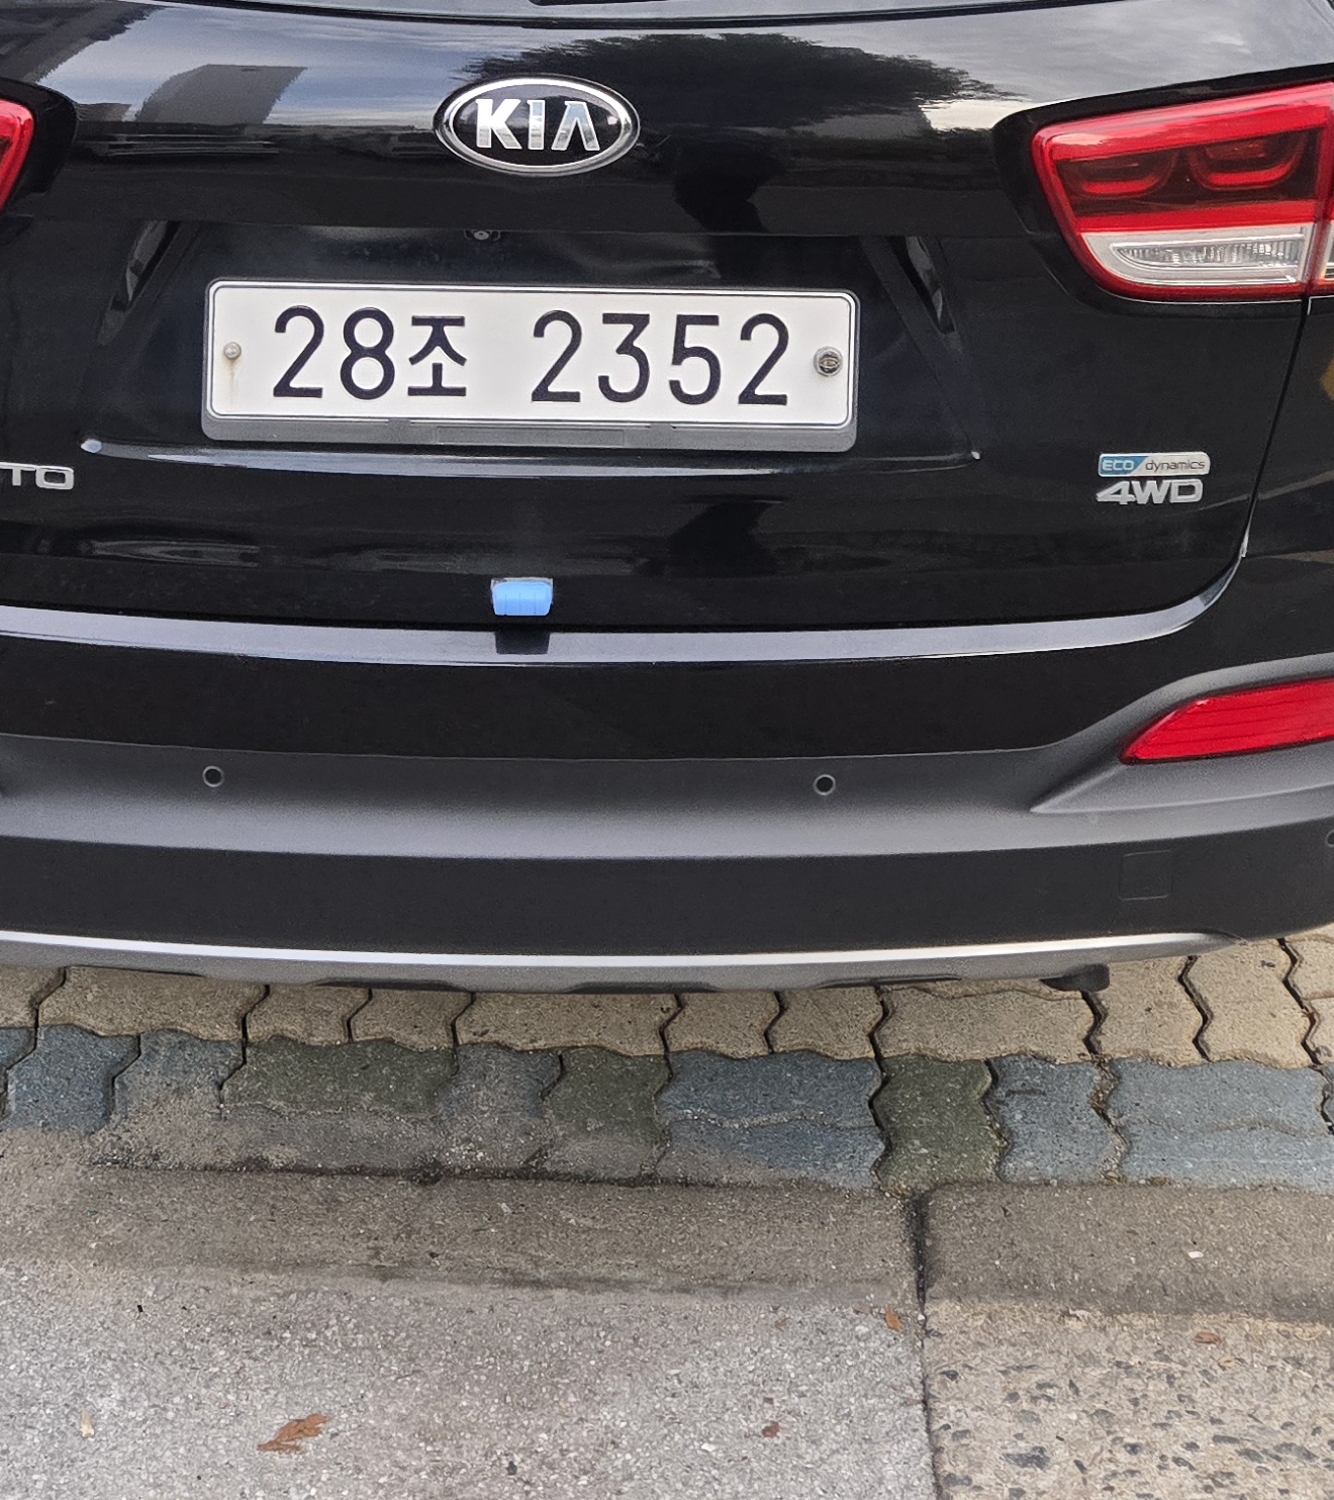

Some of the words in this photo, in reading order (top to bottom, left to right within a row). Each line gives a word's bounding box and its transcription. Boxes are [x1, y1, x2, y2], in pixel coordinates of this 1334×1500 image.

[475, 99, 600, 151] KIA
[273, 305, 467, 398] 28조
[530, 309, 792, 406] 2352
[1101, 460, 1134, 471] ECO
[1145, 460, 1205, 473] dynamics
[1095, 479, 1203, 505] 4WD
